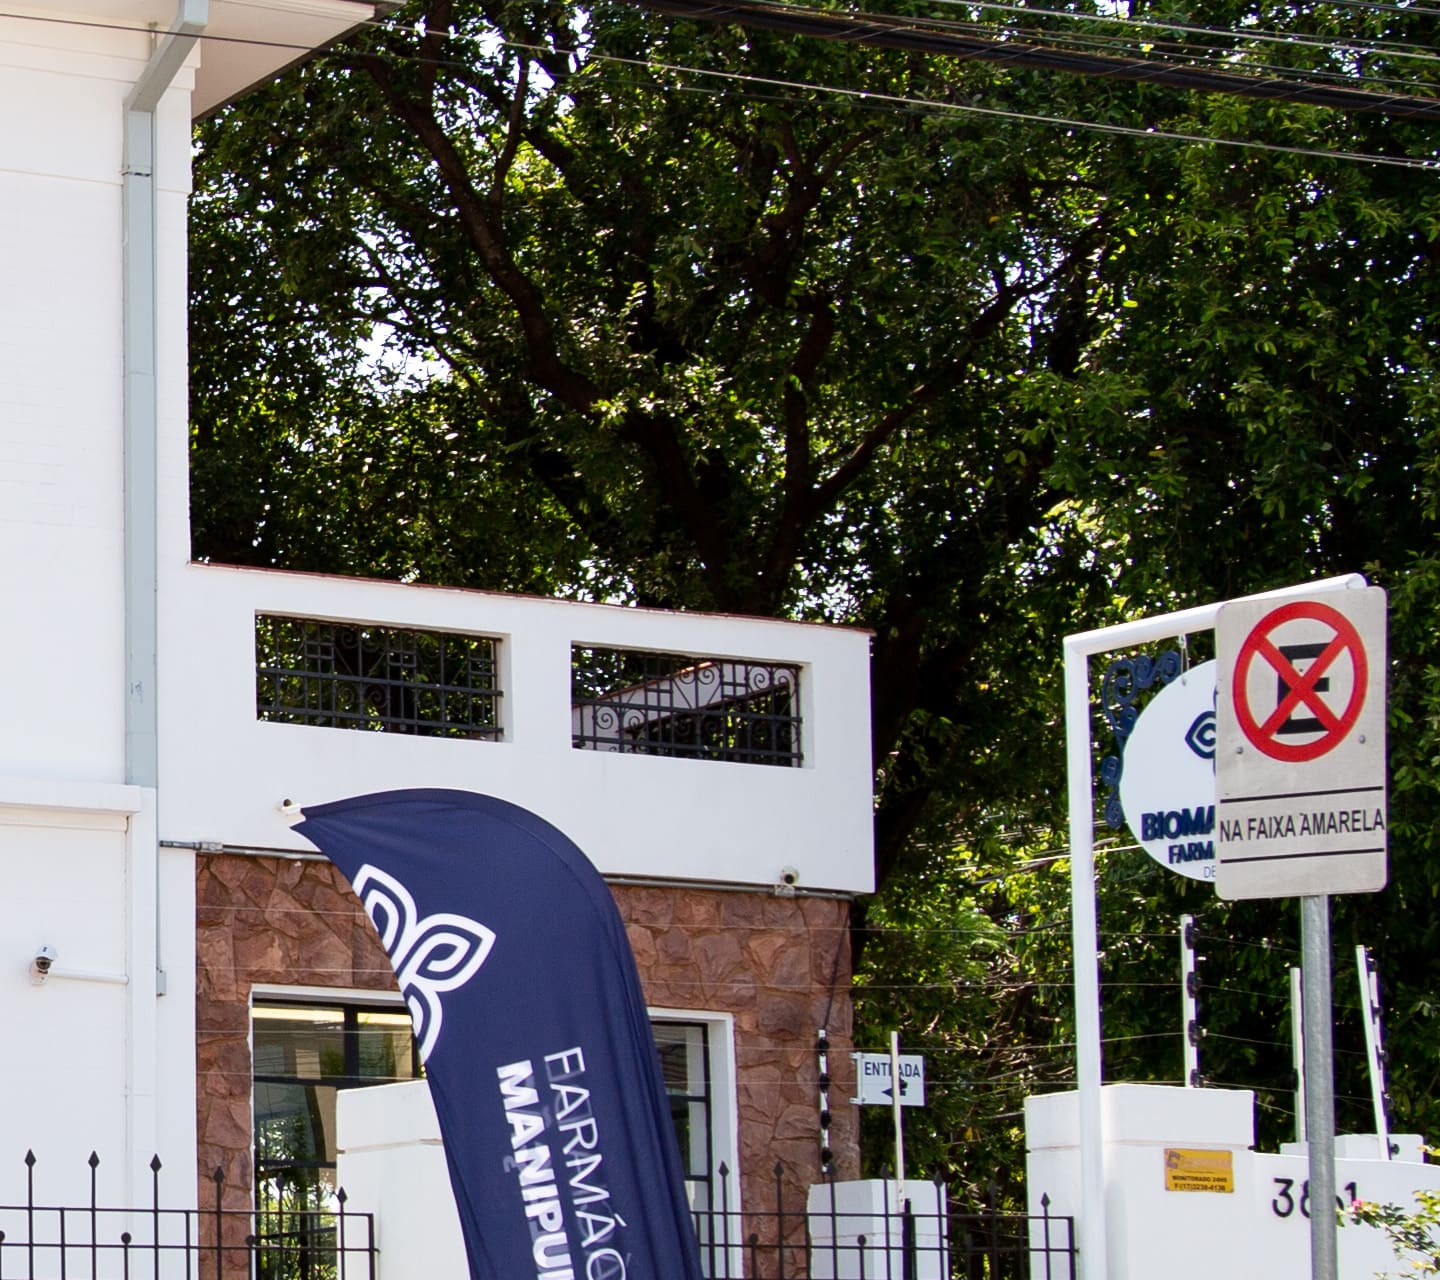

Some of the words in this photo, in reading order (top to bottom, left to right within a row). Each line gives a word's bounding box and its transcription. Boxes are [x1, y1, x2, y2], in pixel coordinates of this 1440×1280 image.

[1220, 820, 1243, 842] NA
[1248, 816, 1297, 840] FAIXA
[1300, 808, 1385, 836] AMARELA
[864, 1061, 921, 1077] ENTADA
